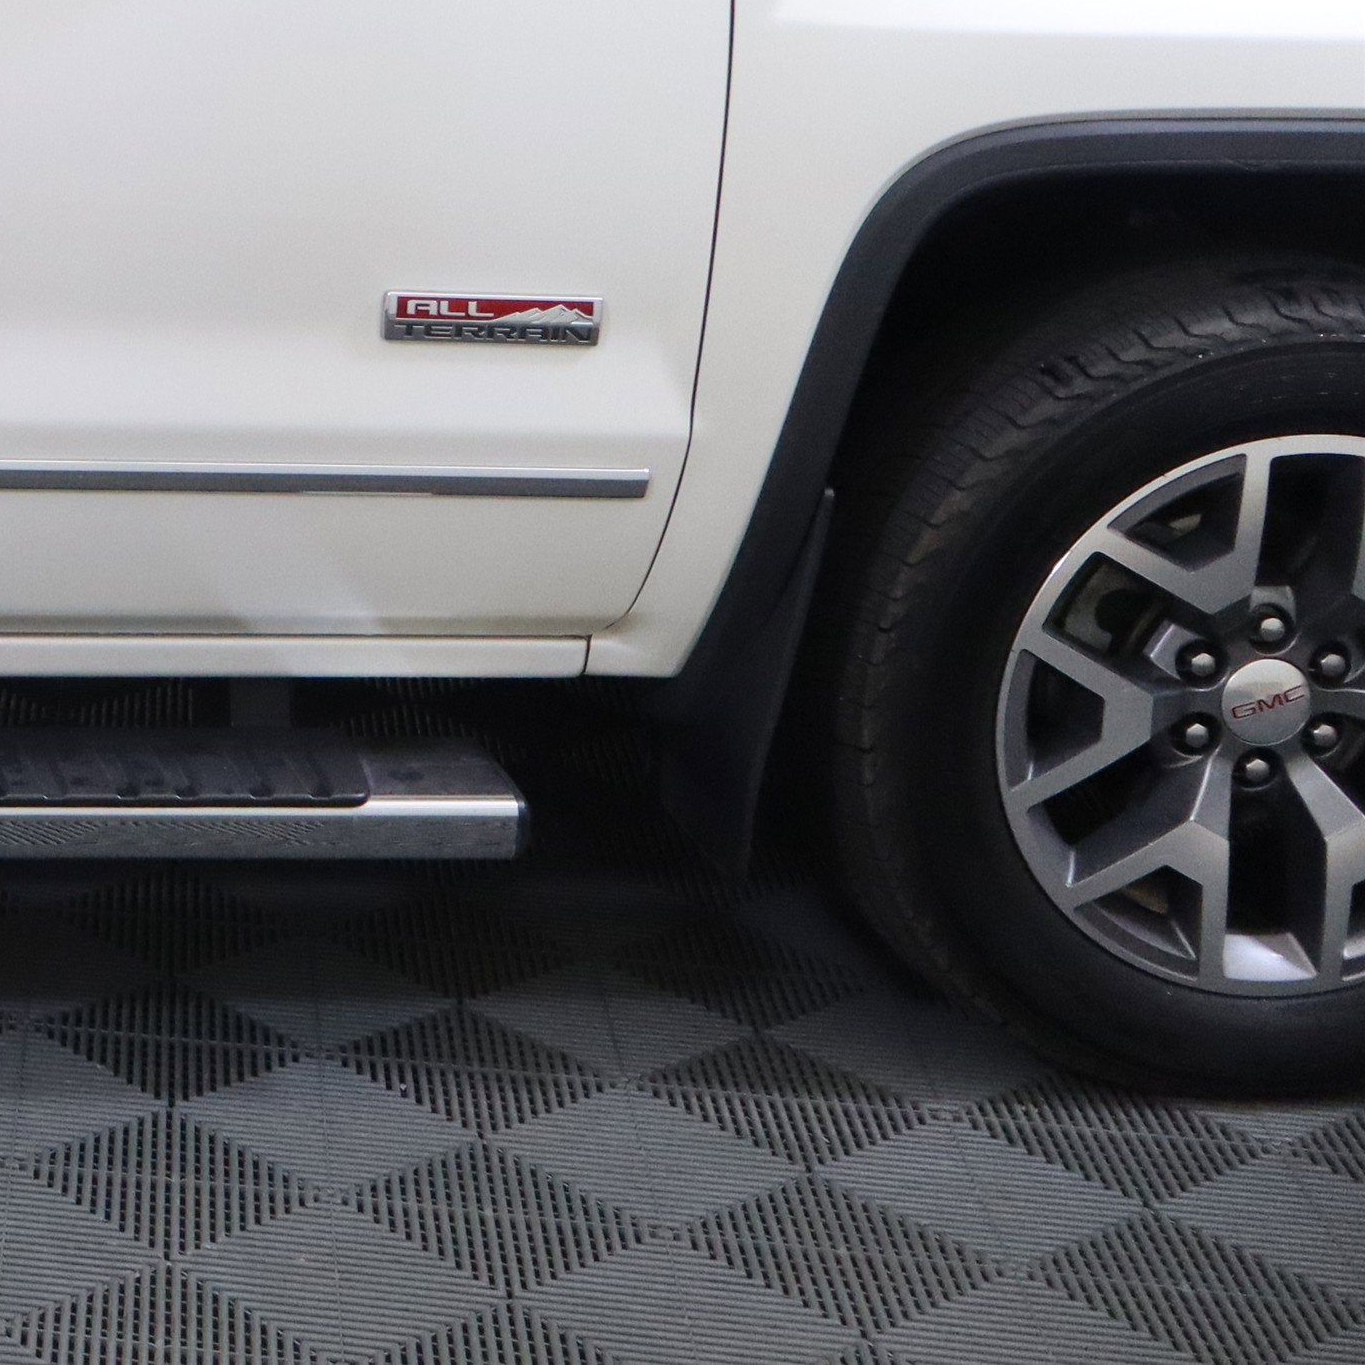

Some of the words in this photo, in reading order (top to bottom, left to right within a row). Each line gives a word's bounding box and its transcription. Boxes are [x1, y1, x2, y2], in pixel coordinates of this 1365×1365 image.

[405, 299, 495, 318] ALL
[394, 323, 594, 344] TERRAIN
[1230, 685, 1306, 720] GMC
